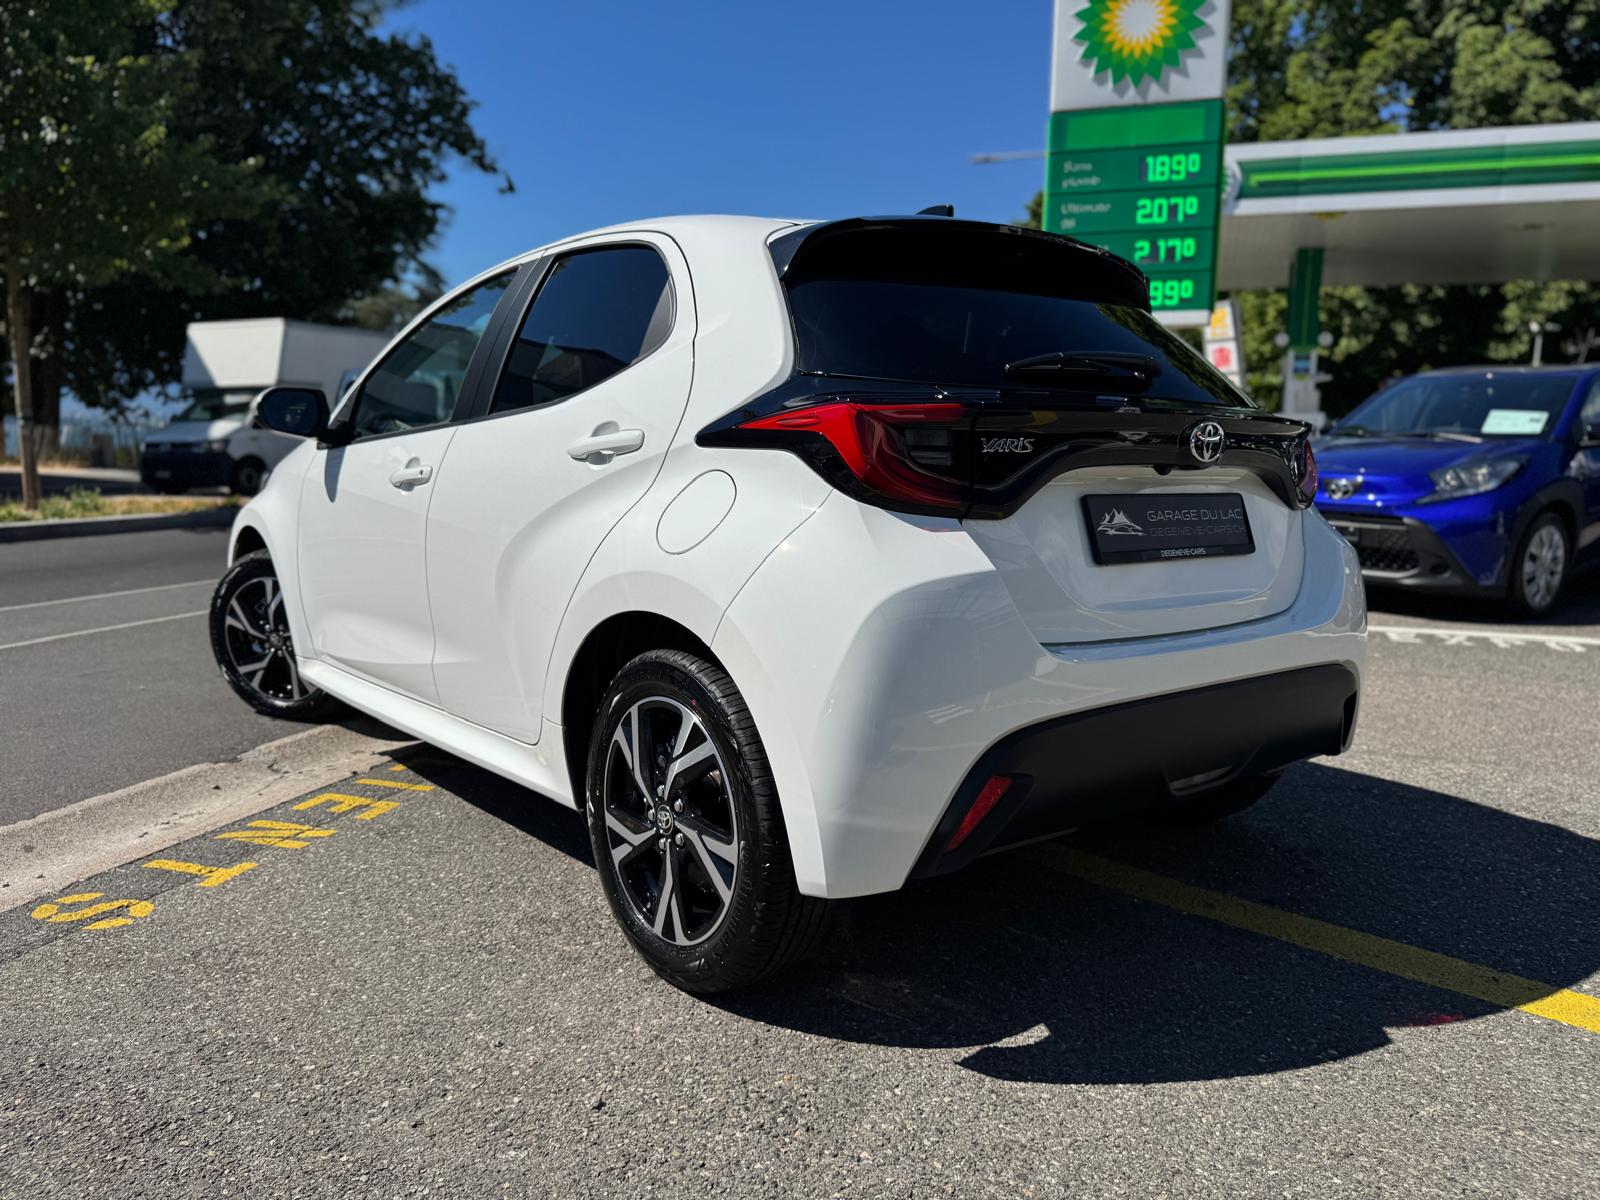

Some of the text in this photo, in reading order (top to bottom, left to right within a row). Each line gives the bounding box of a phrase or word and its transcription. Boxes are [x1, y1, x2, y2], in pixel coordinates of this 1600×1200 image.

[981, 437, 1035, 453] YARIS
[1146, 508, 1243, 522] GARAGE DU LAC
